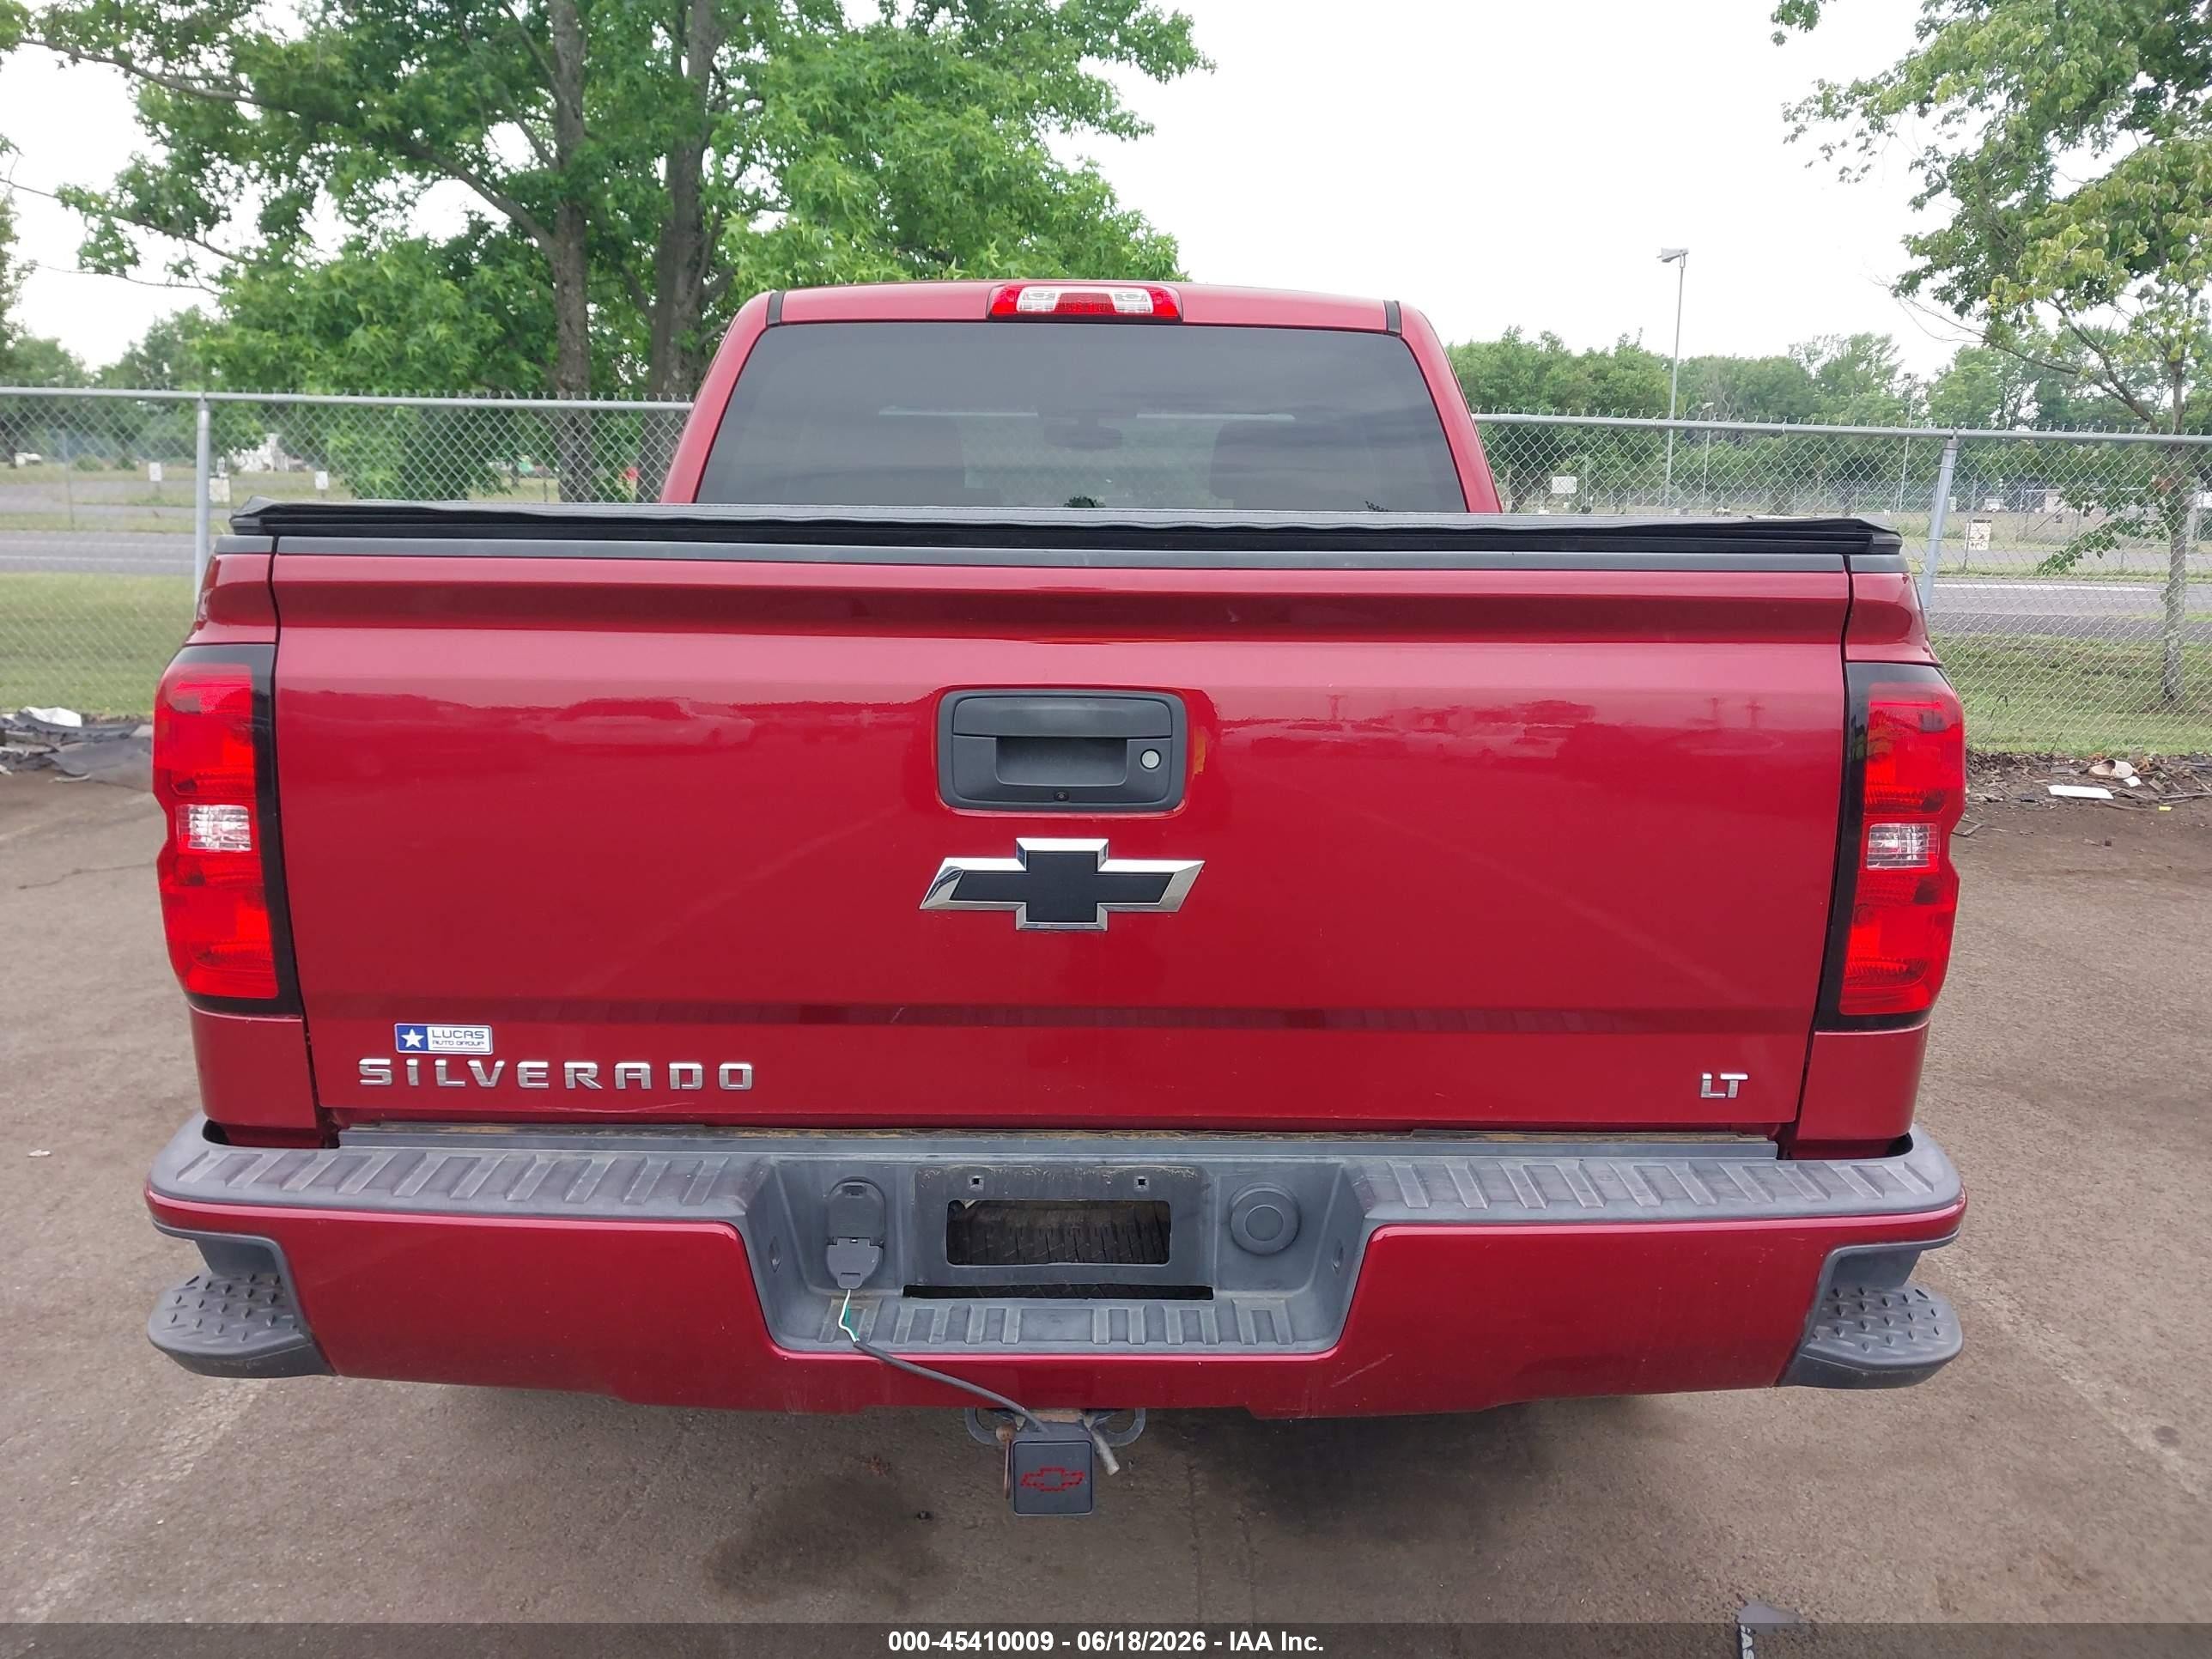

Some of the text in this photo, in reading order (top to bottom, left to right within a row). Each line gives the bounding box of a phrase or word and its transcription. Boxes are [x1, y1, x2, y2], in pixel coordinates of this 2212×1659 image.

[432, 1030, 484, 1039] LUCAS
[358, 1058, 754, 1091] SILVERADO
[1700, 1072, 1749, 1098] LT
